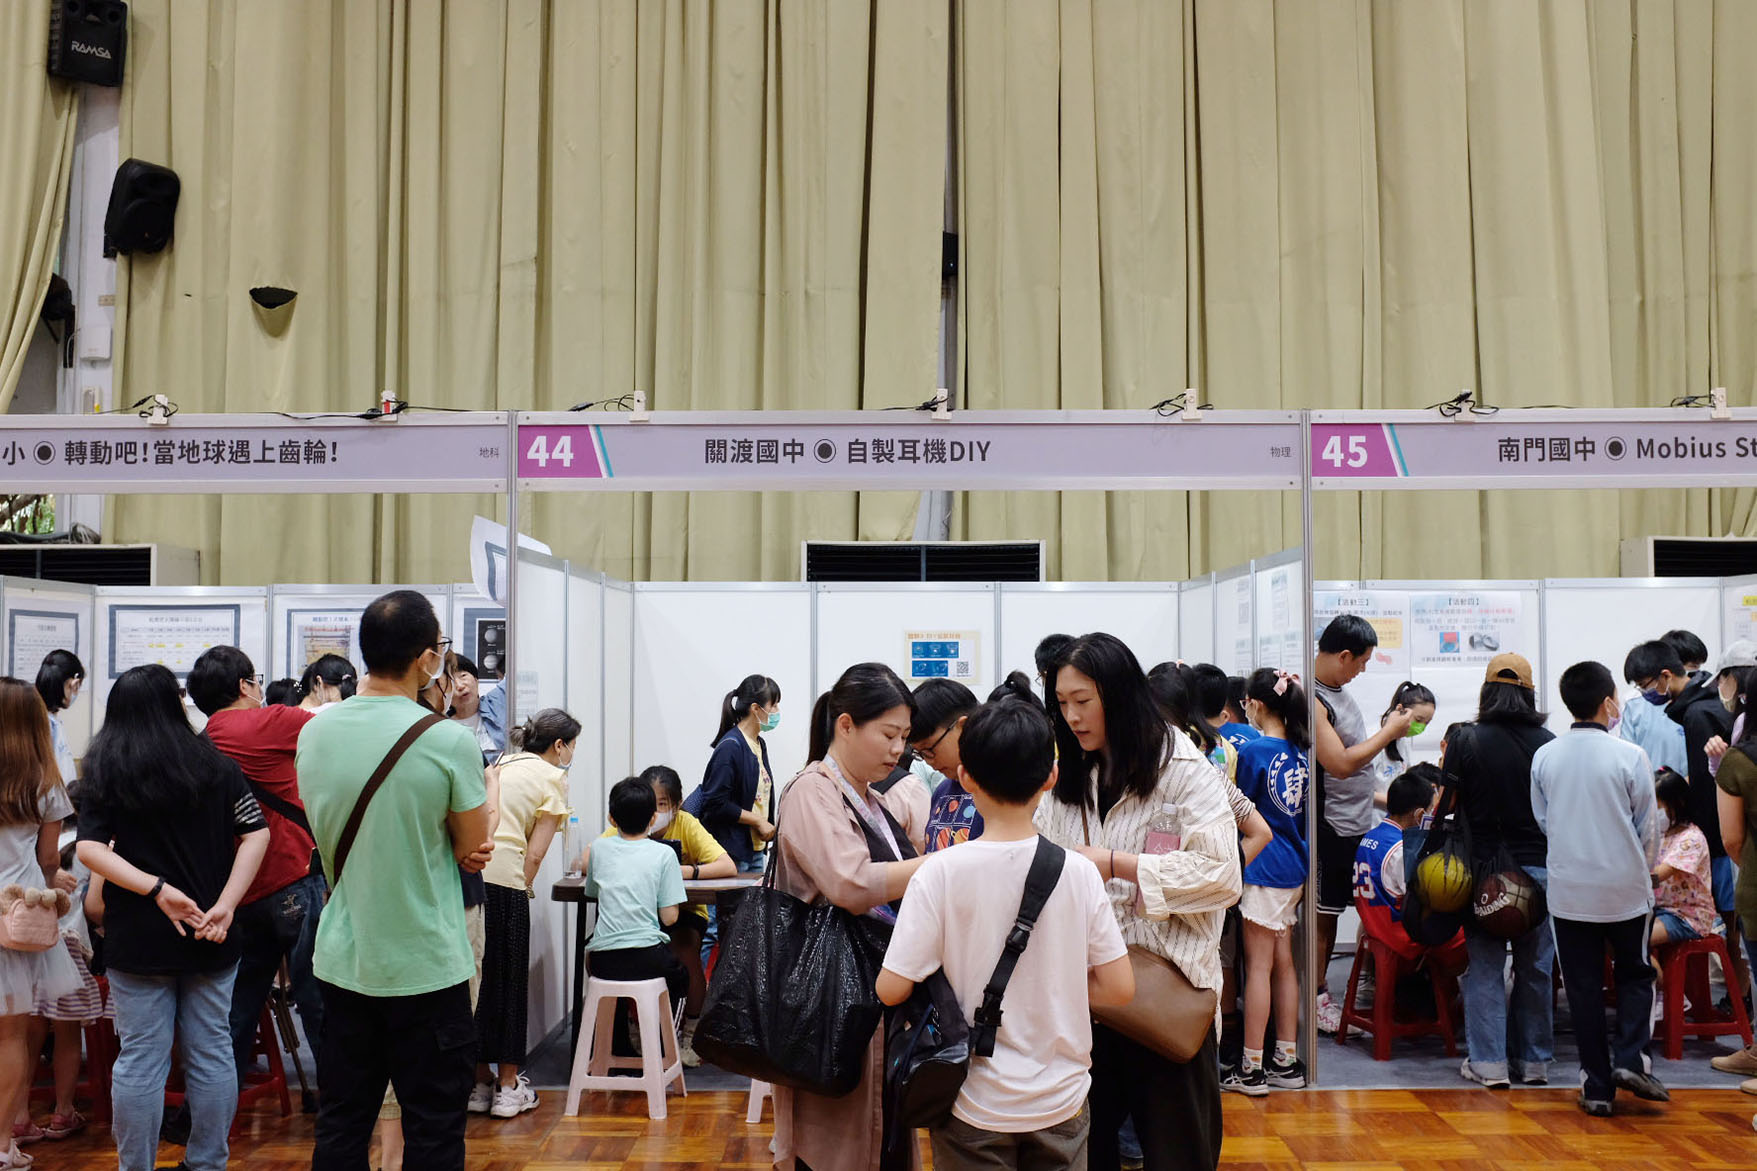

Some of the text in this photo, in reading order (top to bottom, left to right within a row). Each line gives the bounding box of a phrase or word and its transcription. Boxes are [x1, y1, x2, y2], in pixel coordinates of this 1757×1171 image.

[71, 40, 112, 60] RAMSA
[2, 440, 26, 465] 小
[480, 447, 499, 458] 地科
[526, 435, 574, 468] 44
[704, 438, 992, 465] 關渡國中 自製耳機DIY
[1270, 446, 1291, 458] 物理
[1321, 435, 1369, 468] 45
[1497, 437, 1596, 463] 南門國中
[1636, 435, 1727, 459] Mobius
